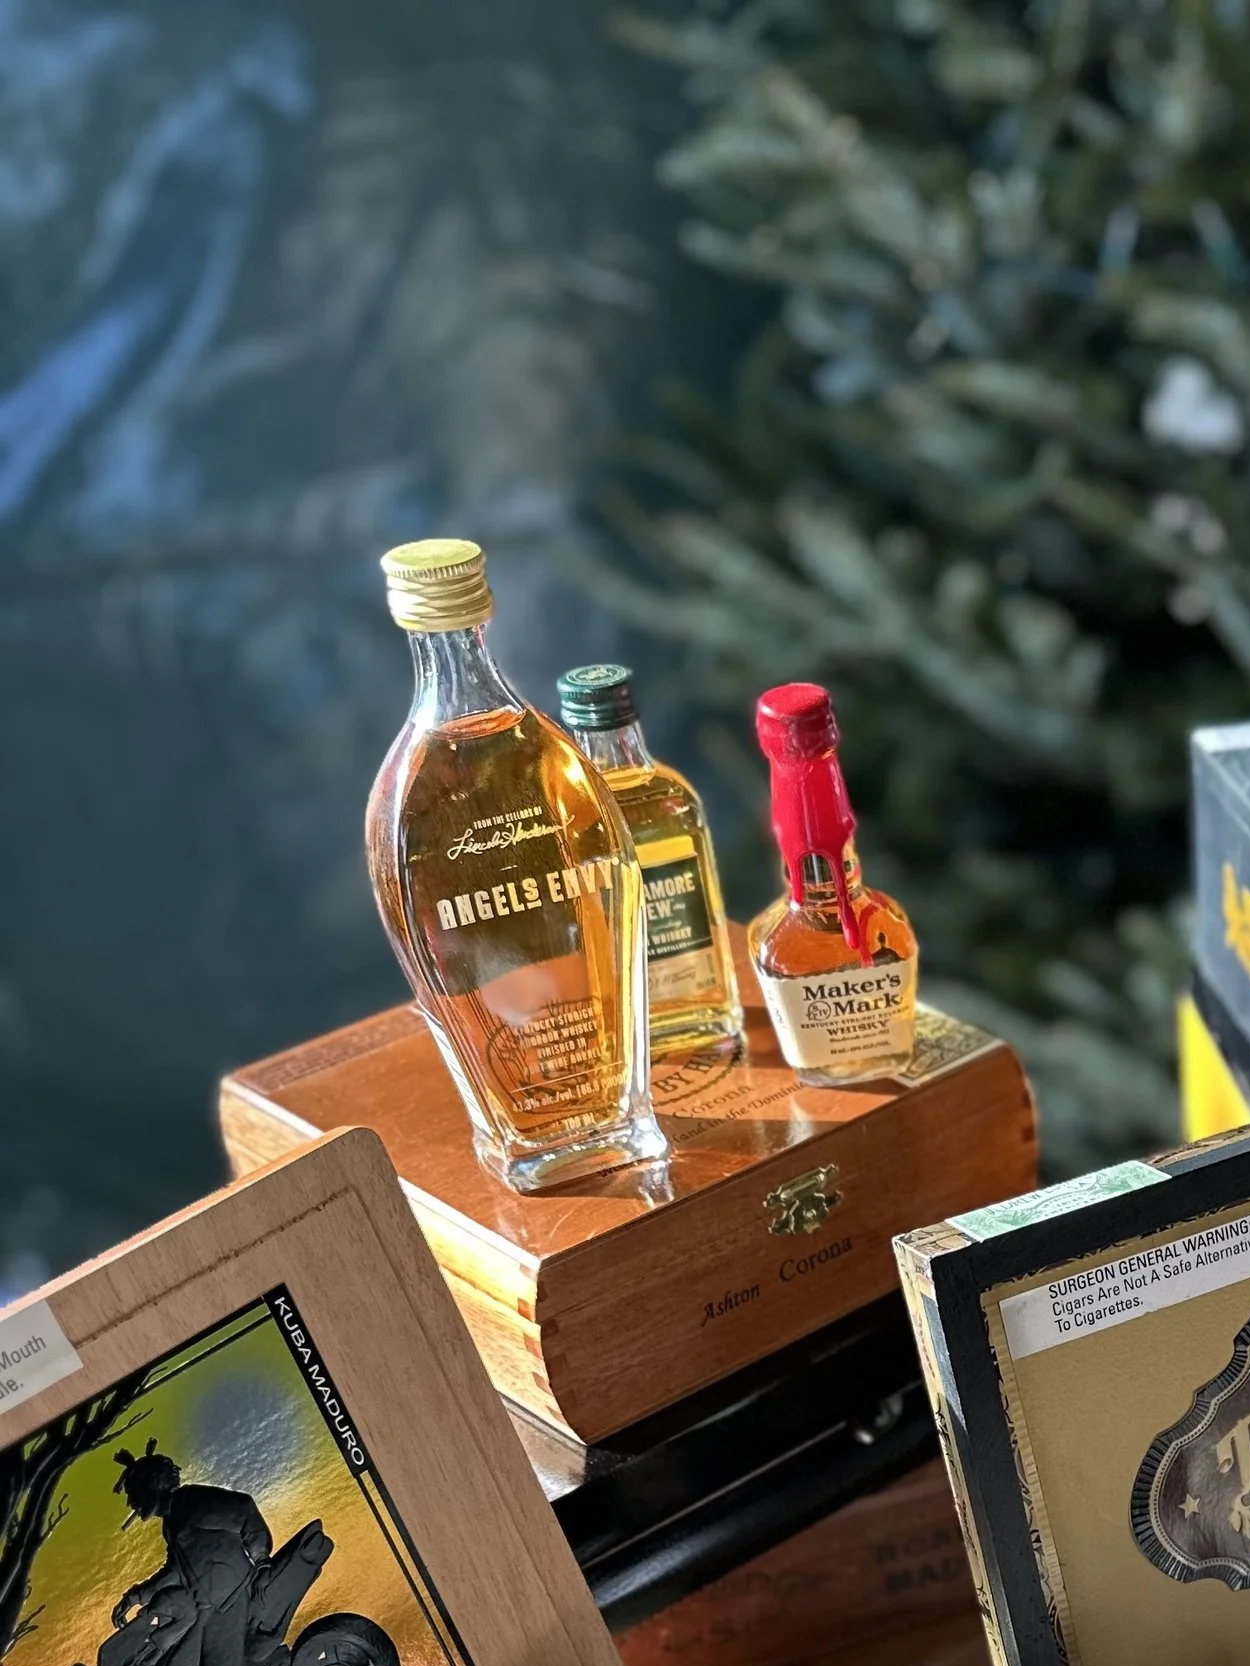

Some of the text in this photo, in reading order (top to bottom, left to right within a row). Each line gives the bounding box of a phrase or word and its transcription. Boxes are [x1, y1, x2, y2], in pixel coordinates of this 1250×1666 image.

[546, 860, 614, 903] ENVY
[802, 973, 902, 1001] Maker's
[833, 993, 900, 1017] Mark
[826, 1018, 889, 1037] WHISKY
[700, 1237, 854, 1328] Ashton Corona
[1048, 1264, 1115, 1300] SURGEON
[1118, 1245, 1181, 1277] GENERAL
[1052, 1293, 1095, 1319] Cigars
[1098, 1285, 1120, 1303] Are
[1124, 1274, 1148, 1293] Not
[1150, 1268, 1161, 1284] A
[1163, 1258, 1192, 1280] Safe
[1054, 1295, 1144, 1335] To Cigarettes.
[274, 1296, 366, 1466] KUBA MADURO
